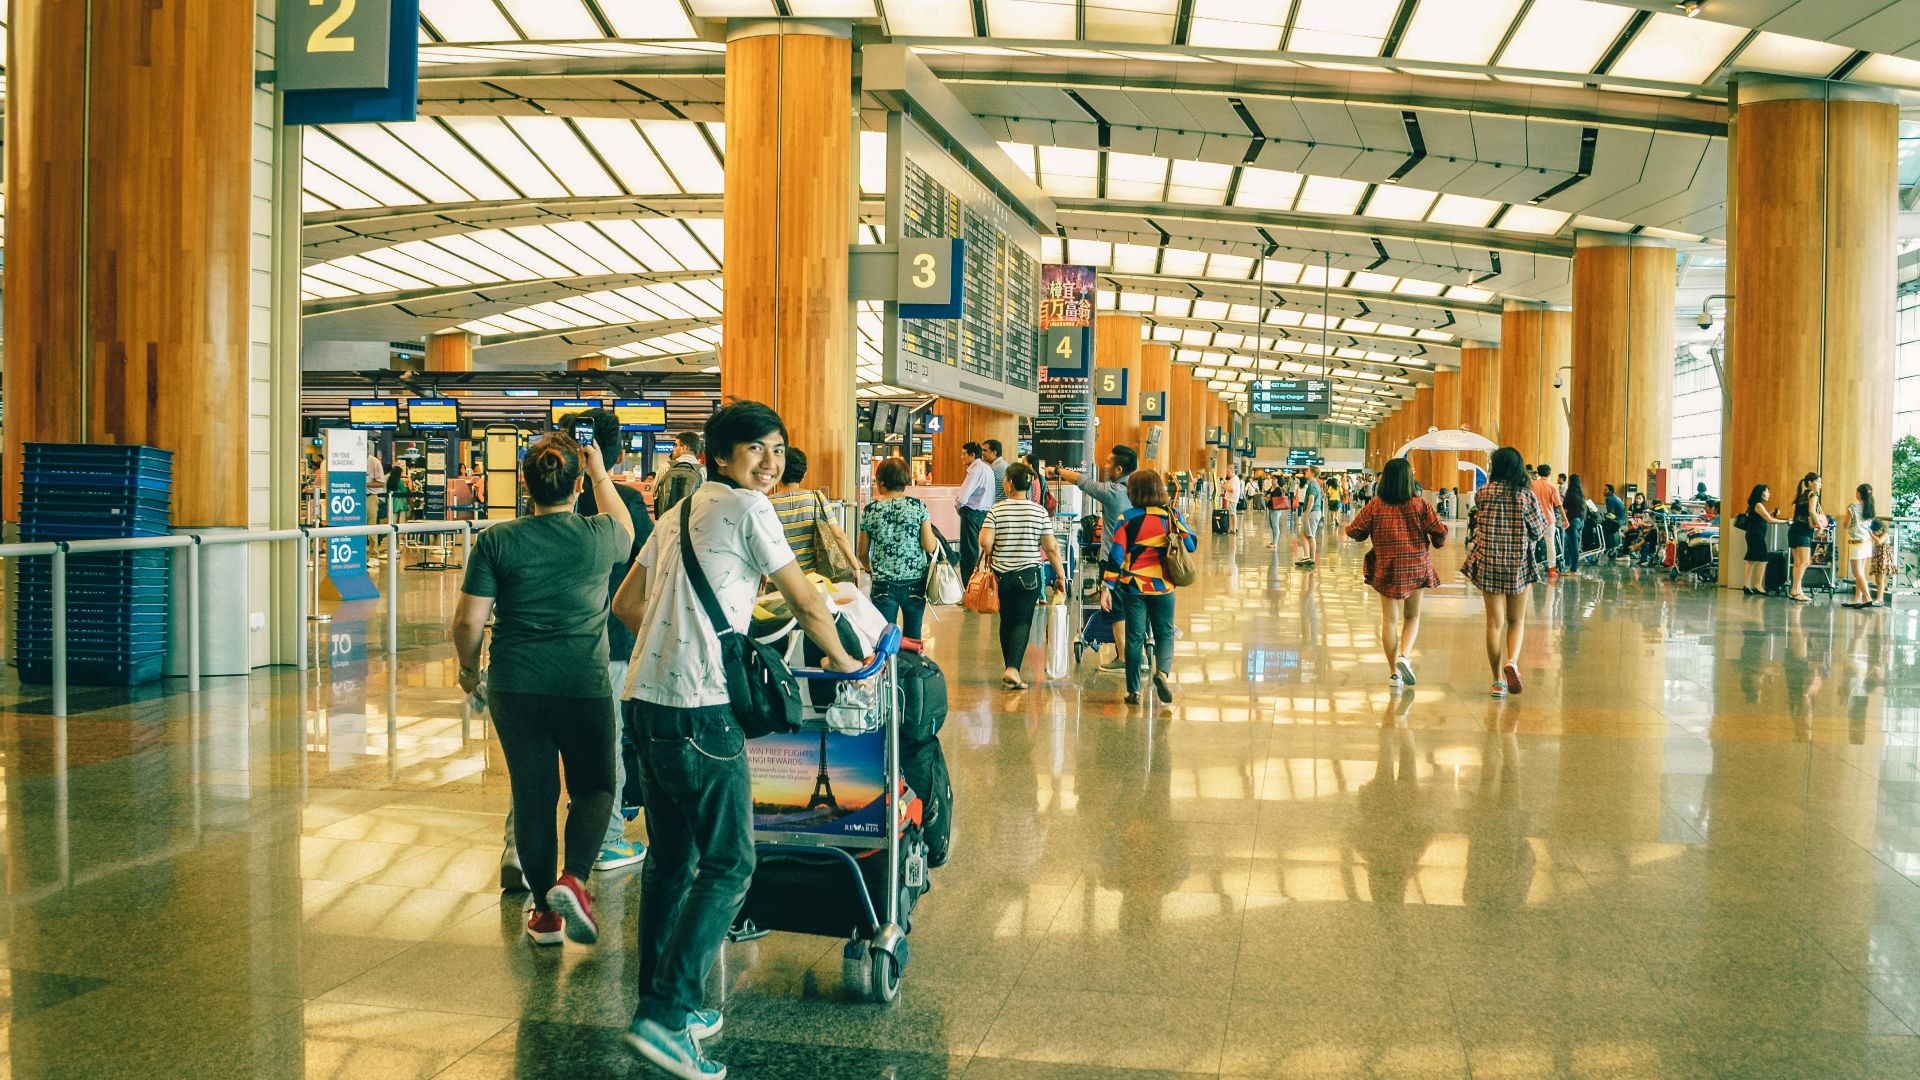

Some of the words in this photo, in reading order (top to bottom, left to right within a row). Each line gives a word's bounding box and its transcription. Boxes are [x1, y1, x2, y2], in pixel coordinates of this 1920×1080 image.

[307, 0, 355, 52] 2
[912, 253, 936, 289] 3
[1056, 335, 1073, 359] 4
[1103, 374, 1116, 392] 5
[1146, 397, 1156, 411] 6
[928, 416, 940, 431] 4
[1209, 430, 1215, 438] 7
[1221, 434, 1226, 443] 8
[1238, 439, 1243, 447] 9
[331, 495, 355, 515] 60
[331, 544, 352, 564] 10
[748, 747, 764, 755] WIN
[765, 748, 781, 756] FREE
[783, 749, 814, 758] FLIGHTS
[768, 757, 802, 766] REWARDS
